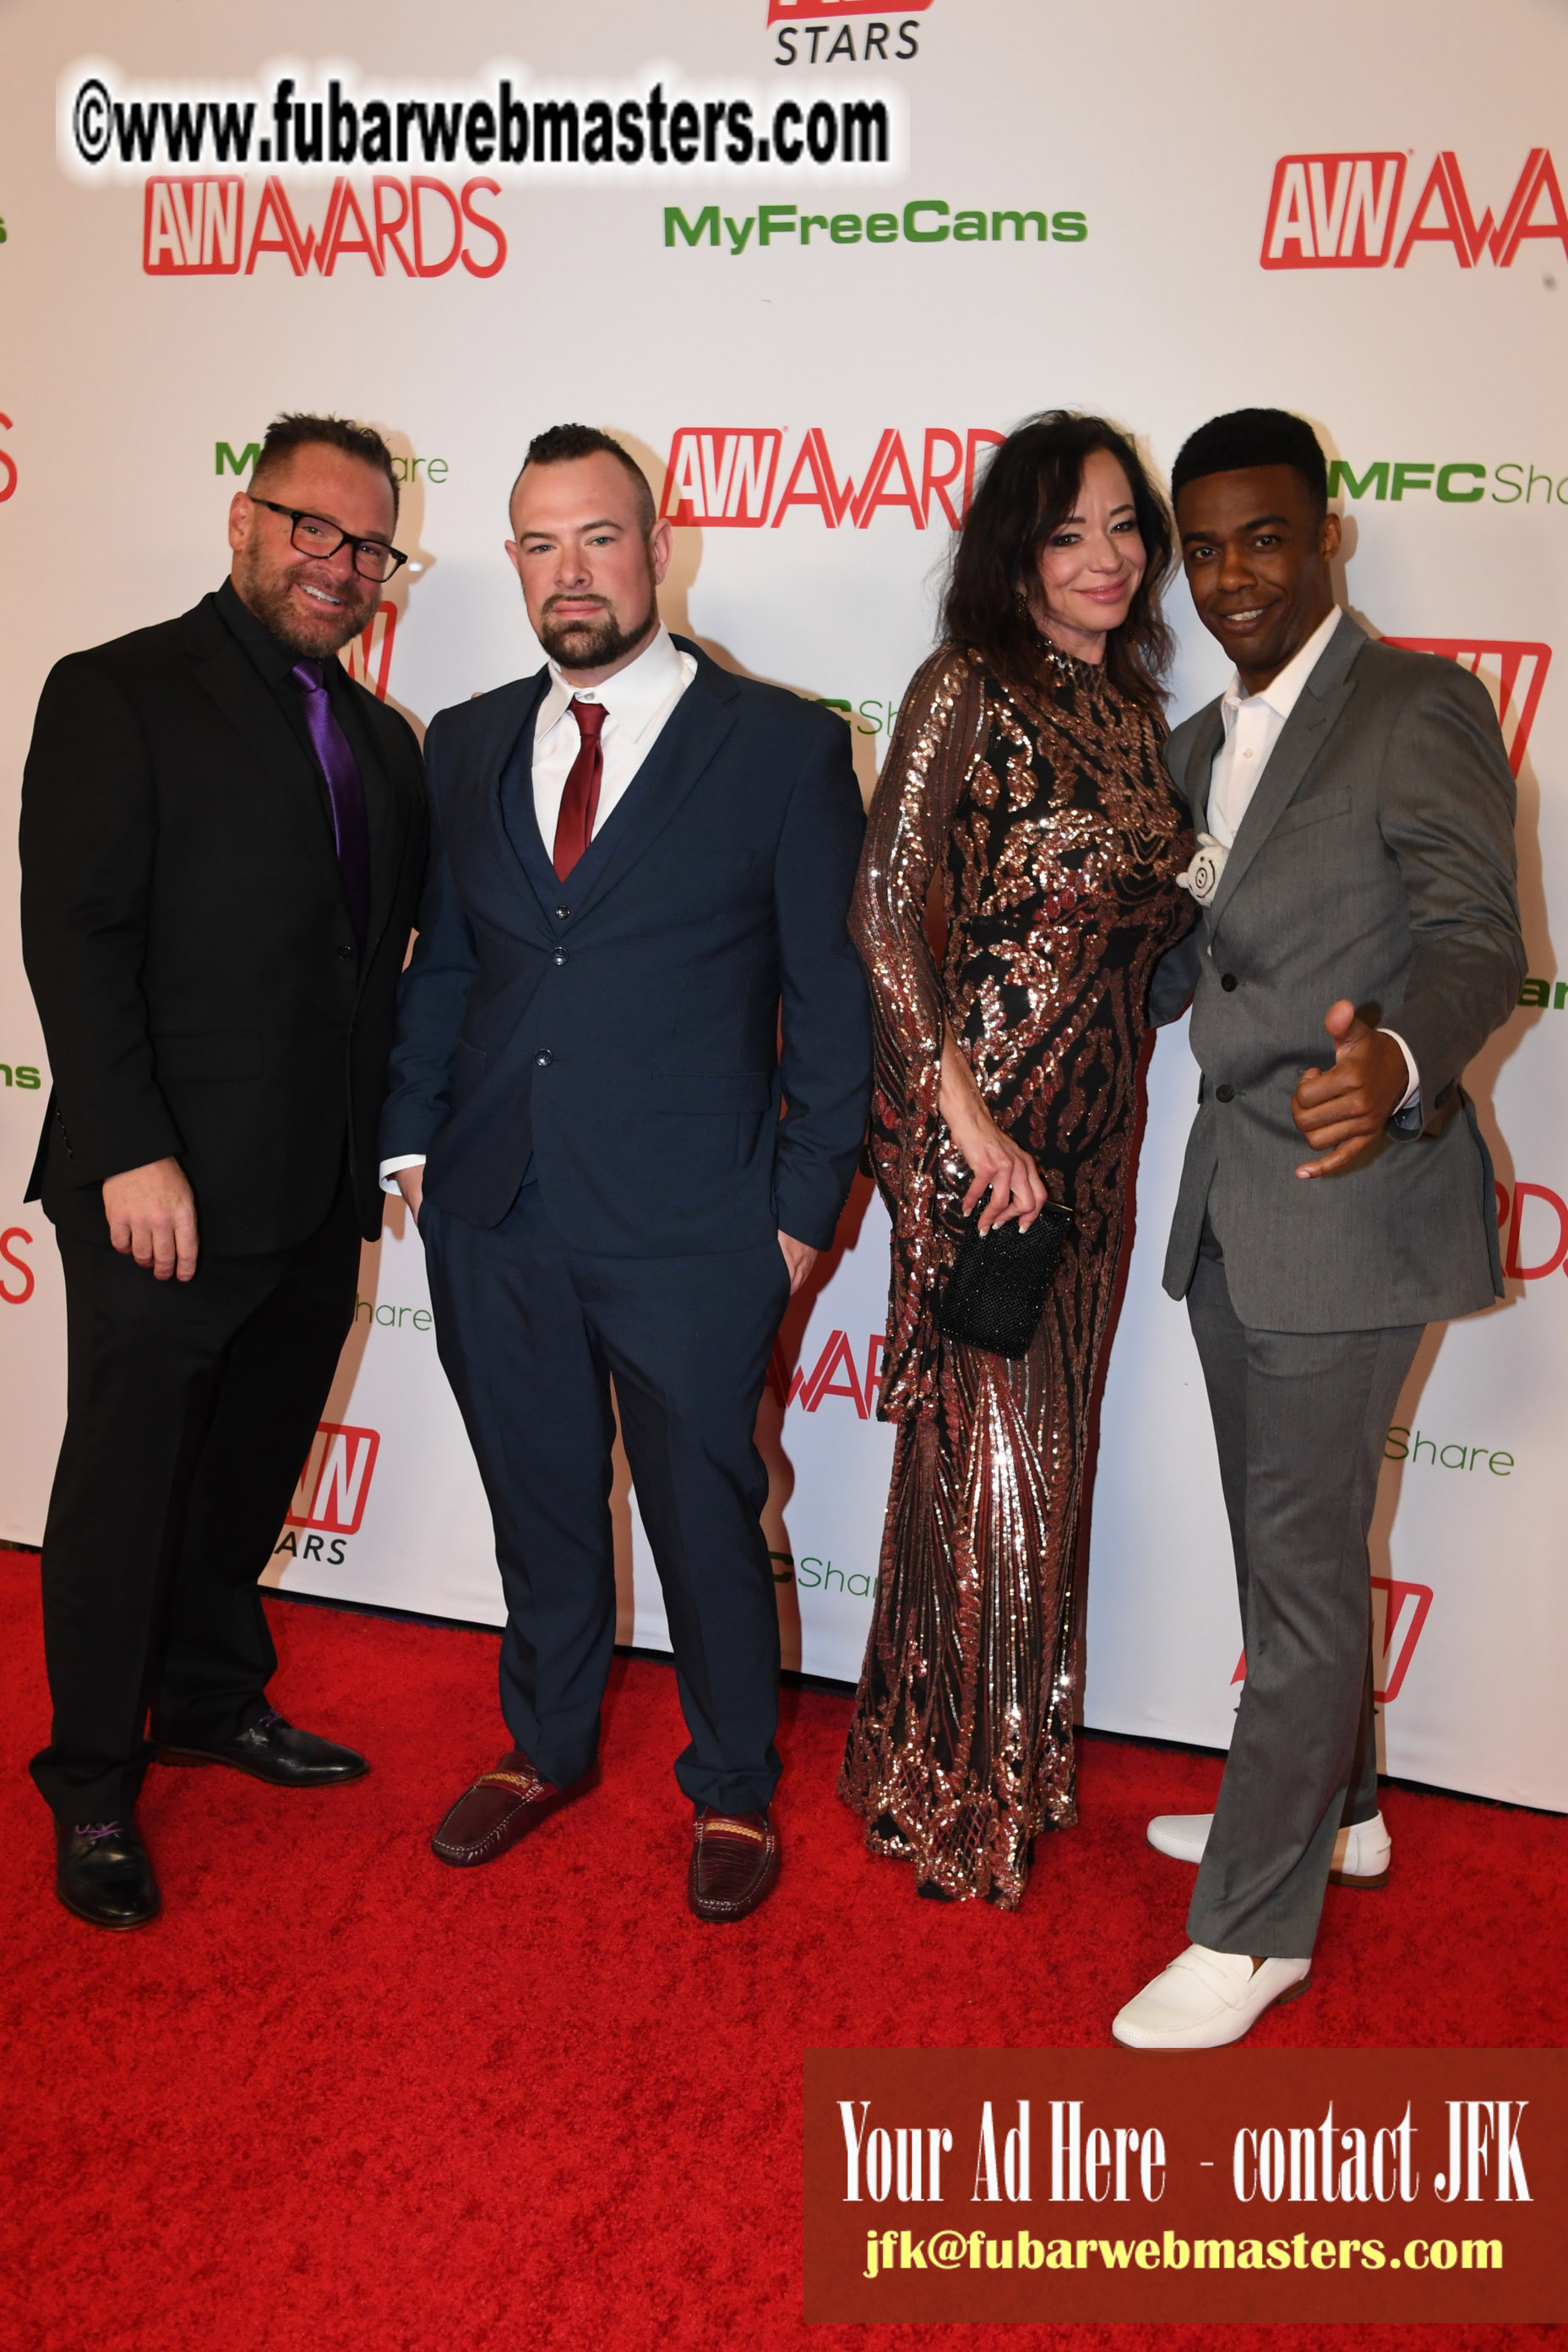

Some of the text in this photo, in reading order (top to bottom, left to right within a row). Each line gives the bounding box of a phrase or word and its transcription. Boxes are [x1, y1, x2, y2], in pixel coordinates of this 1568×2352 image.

[774, 19, 921, 66] STARS
[147, 174, 508, 279] AVN AWARDS
[663, 199, 1088, 256] MyFreeCams
[1269, 159, 1399, 259] AVN
[665, 433, 776, 519] AVN
